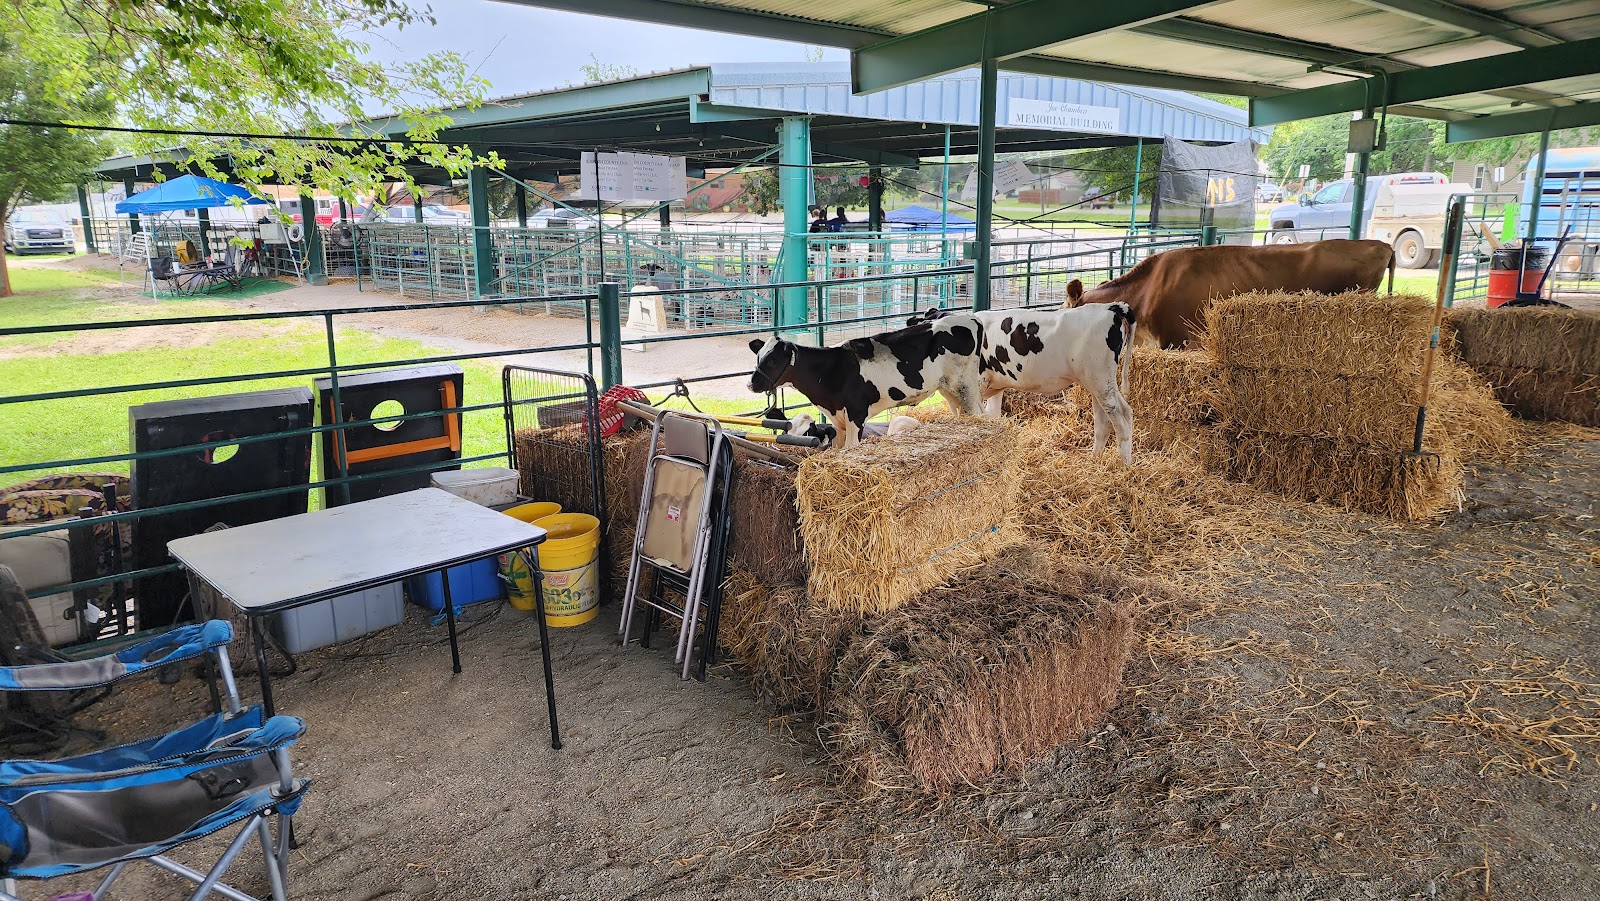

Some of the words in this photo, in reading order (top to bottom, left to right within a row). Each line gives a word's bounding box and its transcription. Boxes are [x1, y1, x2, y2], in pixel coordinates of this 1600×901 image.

[1046, 102, 1057, 113] Joe
[1015, 113, 1068, 126] MEMORIAL
[1070, 117, 1114, 130] BUILDING
